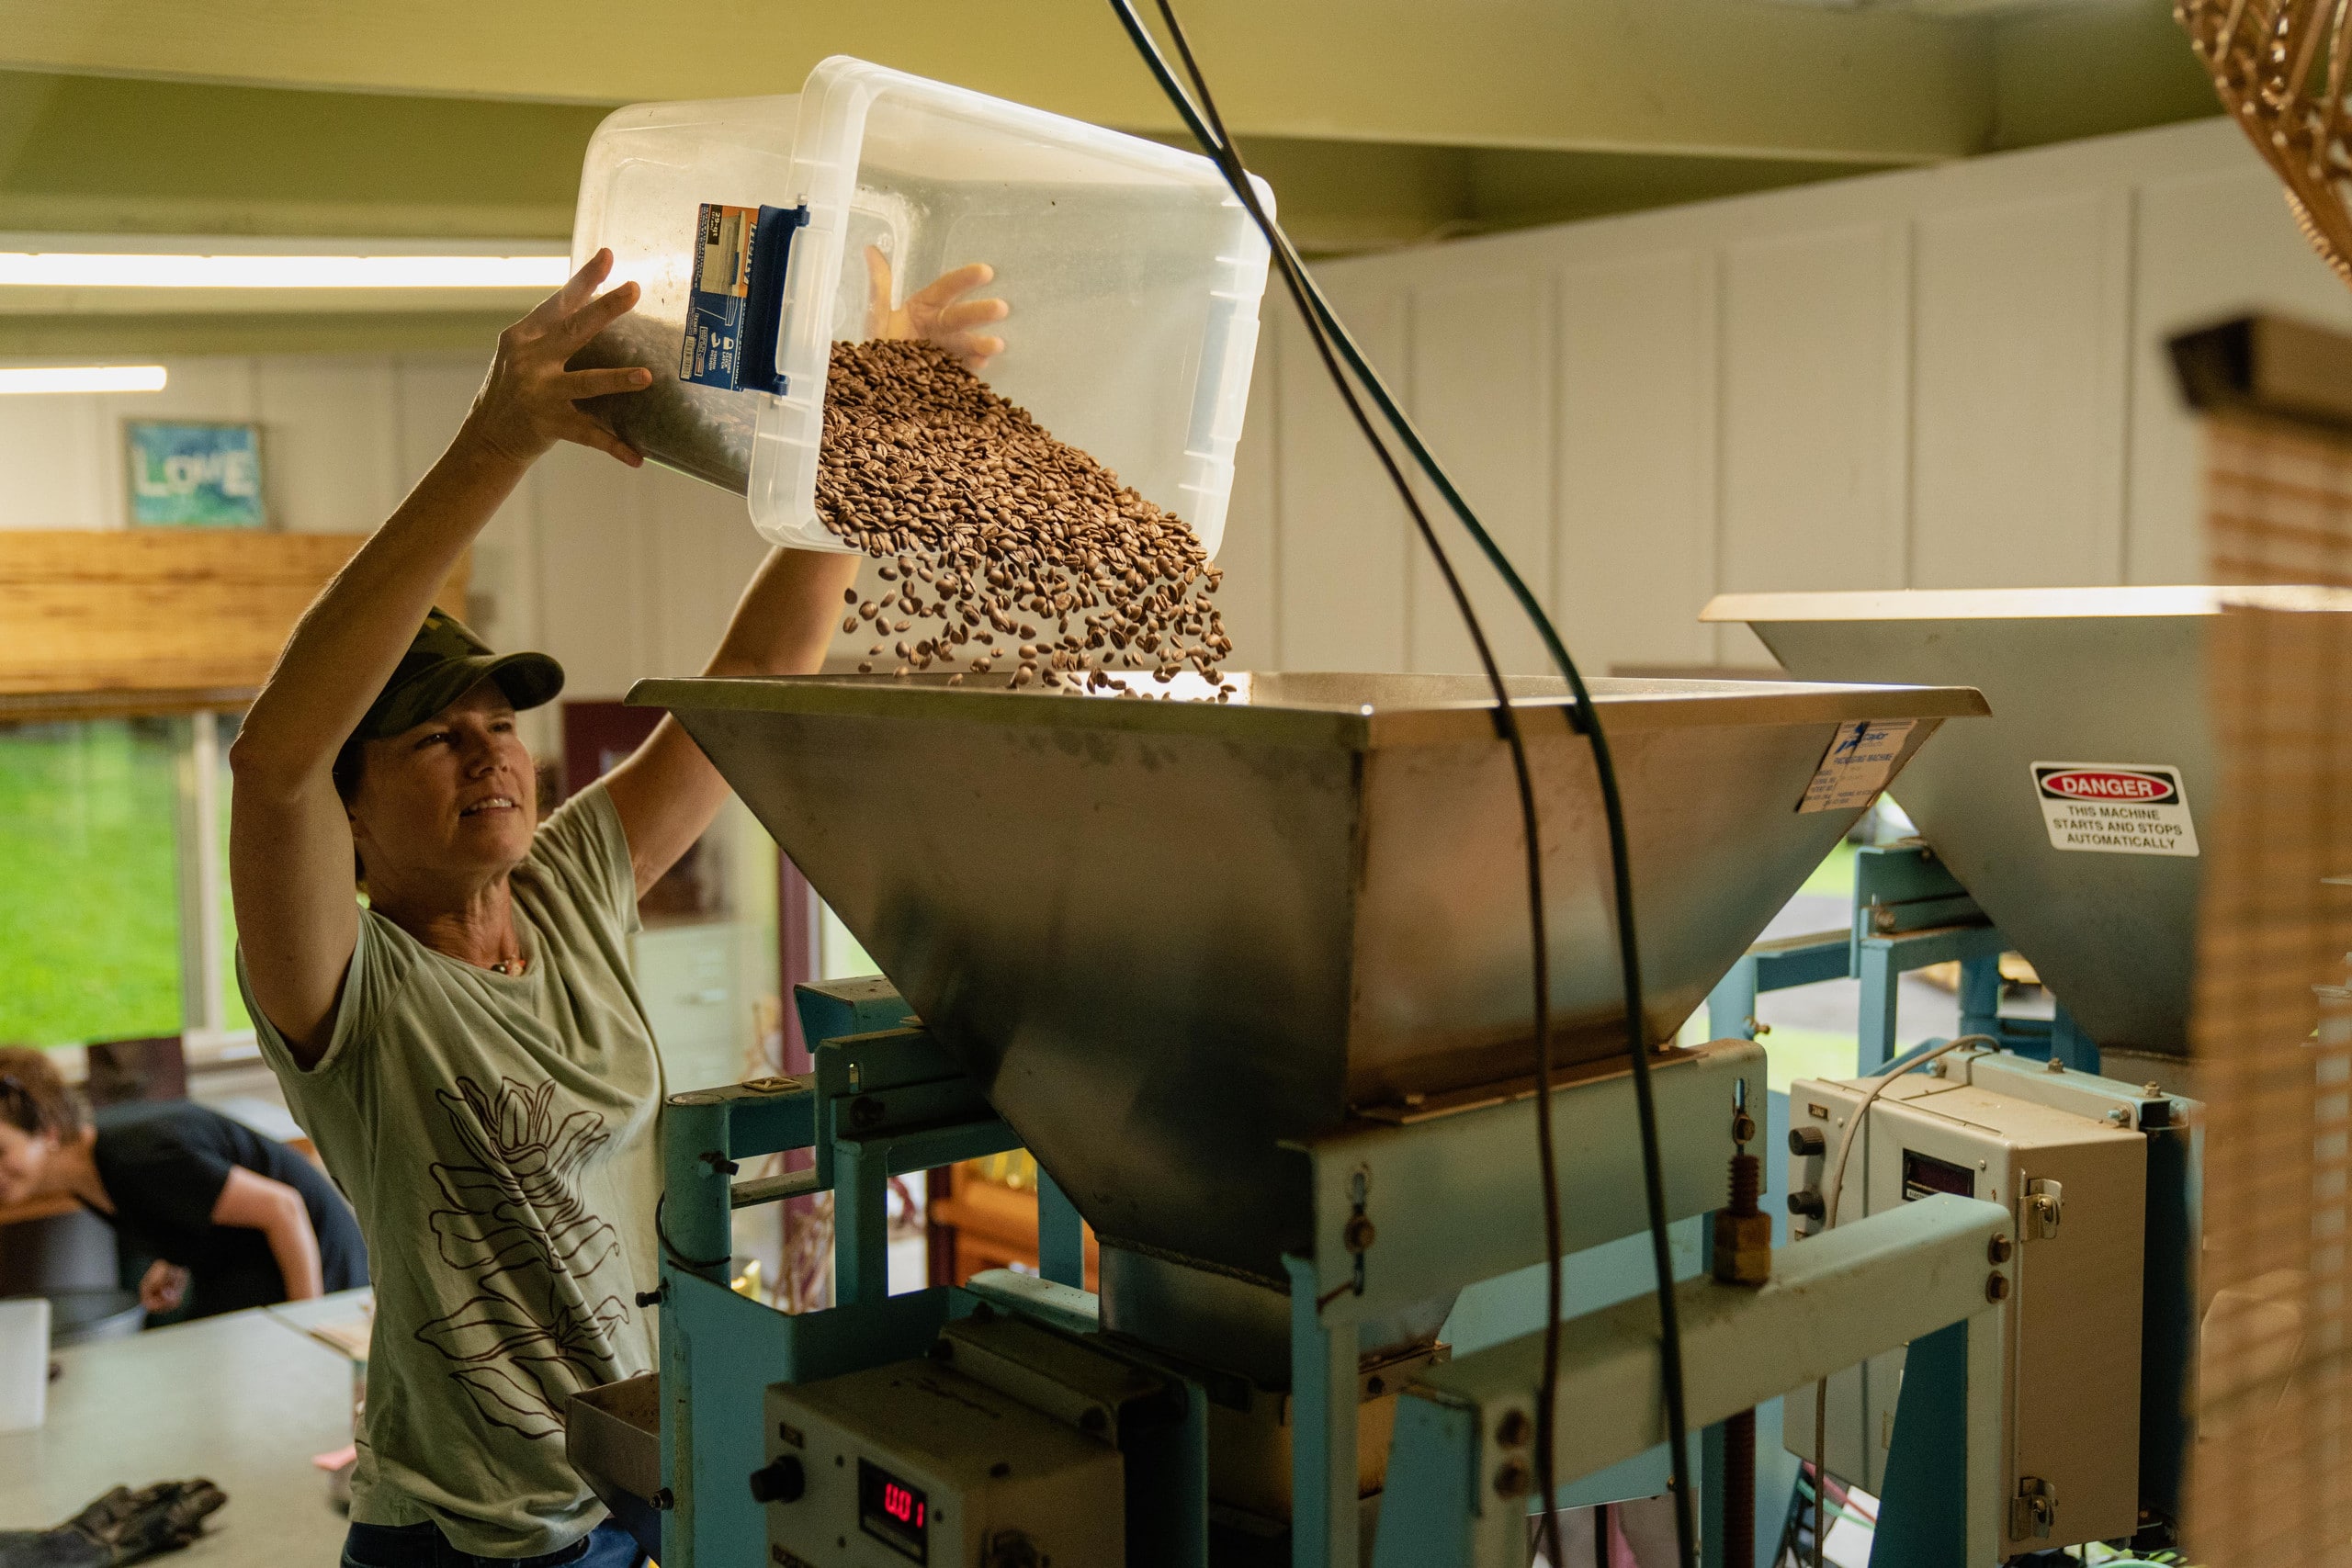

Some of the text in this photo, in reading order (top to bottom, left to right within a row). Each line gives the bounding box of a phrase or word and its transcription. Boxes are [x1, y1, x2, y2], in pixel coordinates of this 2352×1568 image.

[712, 212, 721, 237] 29-qt
[132, 445, 254, 497] LOVE
[2062, 777, 2154, 796] DANGER
[2068, 806, 2160, 820] THIS MACHINE
[2053, 818, 2183, 836] STARTS AND STOPS
[2066, 833, 2176, 850] AUTOMATICALLY
